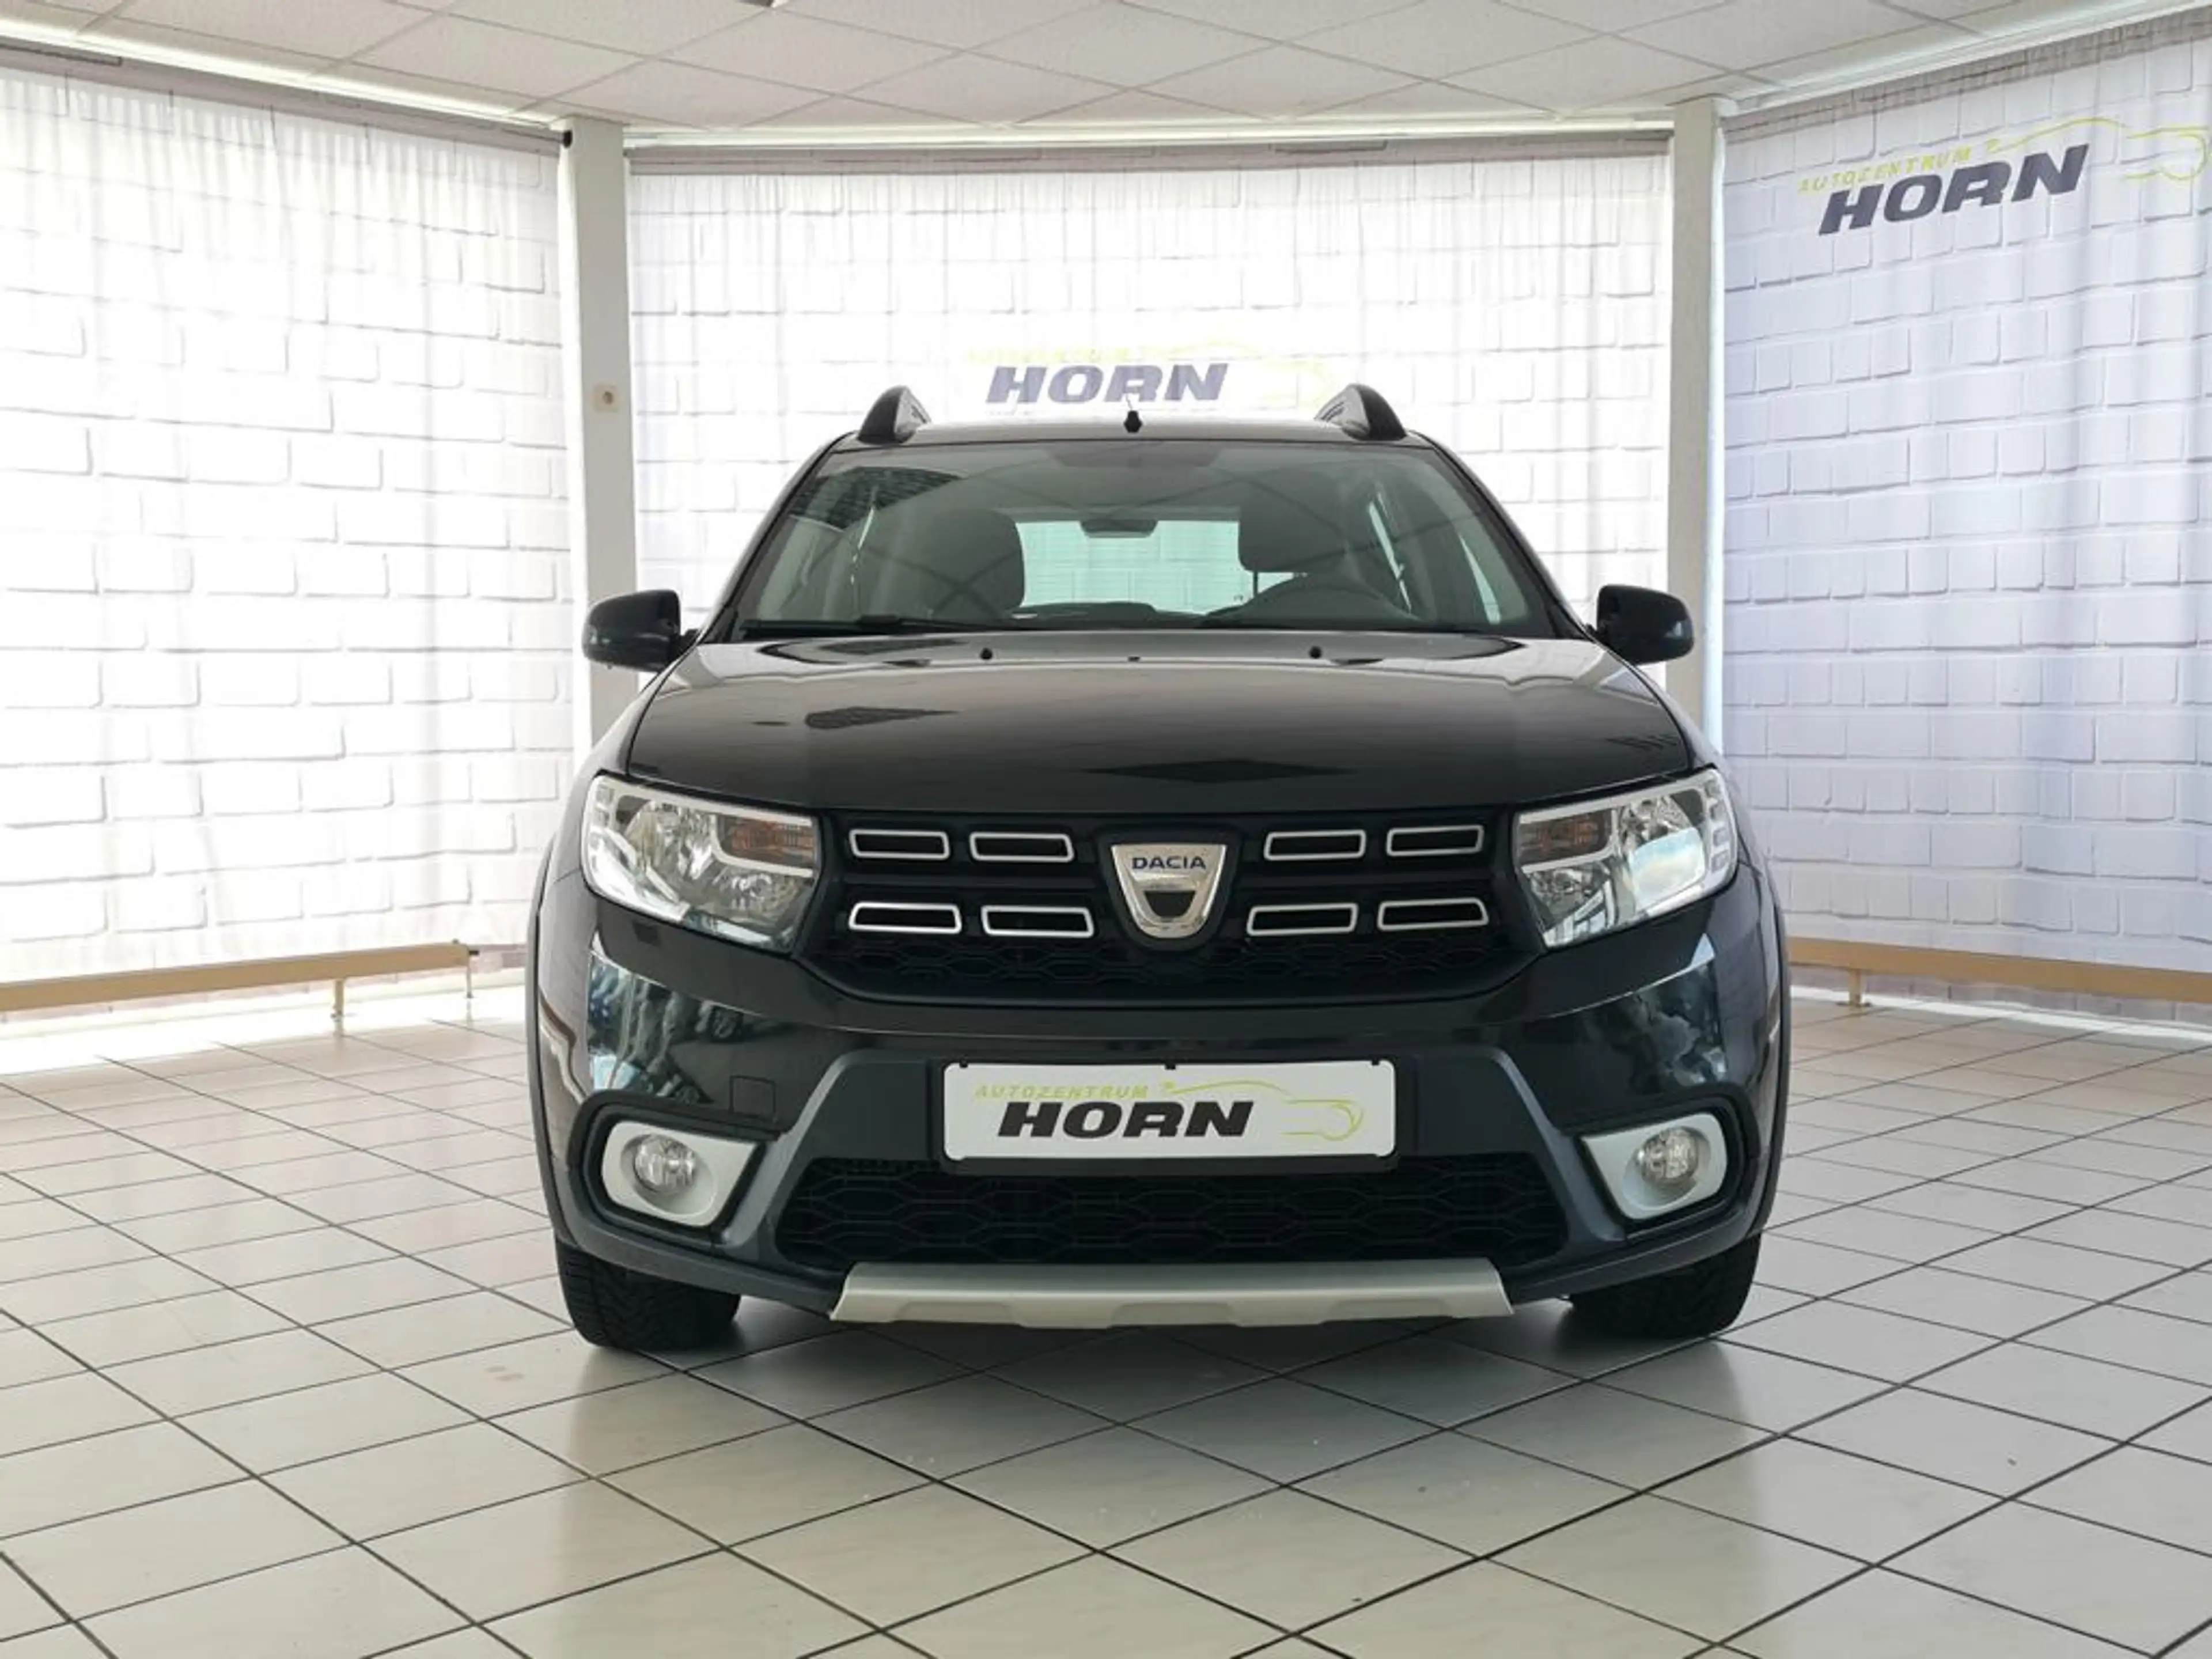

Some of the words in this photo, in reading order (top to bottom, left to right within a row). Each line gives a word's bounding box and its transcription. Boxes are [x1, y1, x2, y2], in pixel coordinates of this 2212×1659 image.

[1819, 144, 2089, 236] HORN
[985, 363, 1228, 404] HORN
[1132, 856, 1207, 870] DACIA
[975, 1085, 1149, 1100] AUTOZENTRUM
[998, 1101, 1254, 1139] HORN
